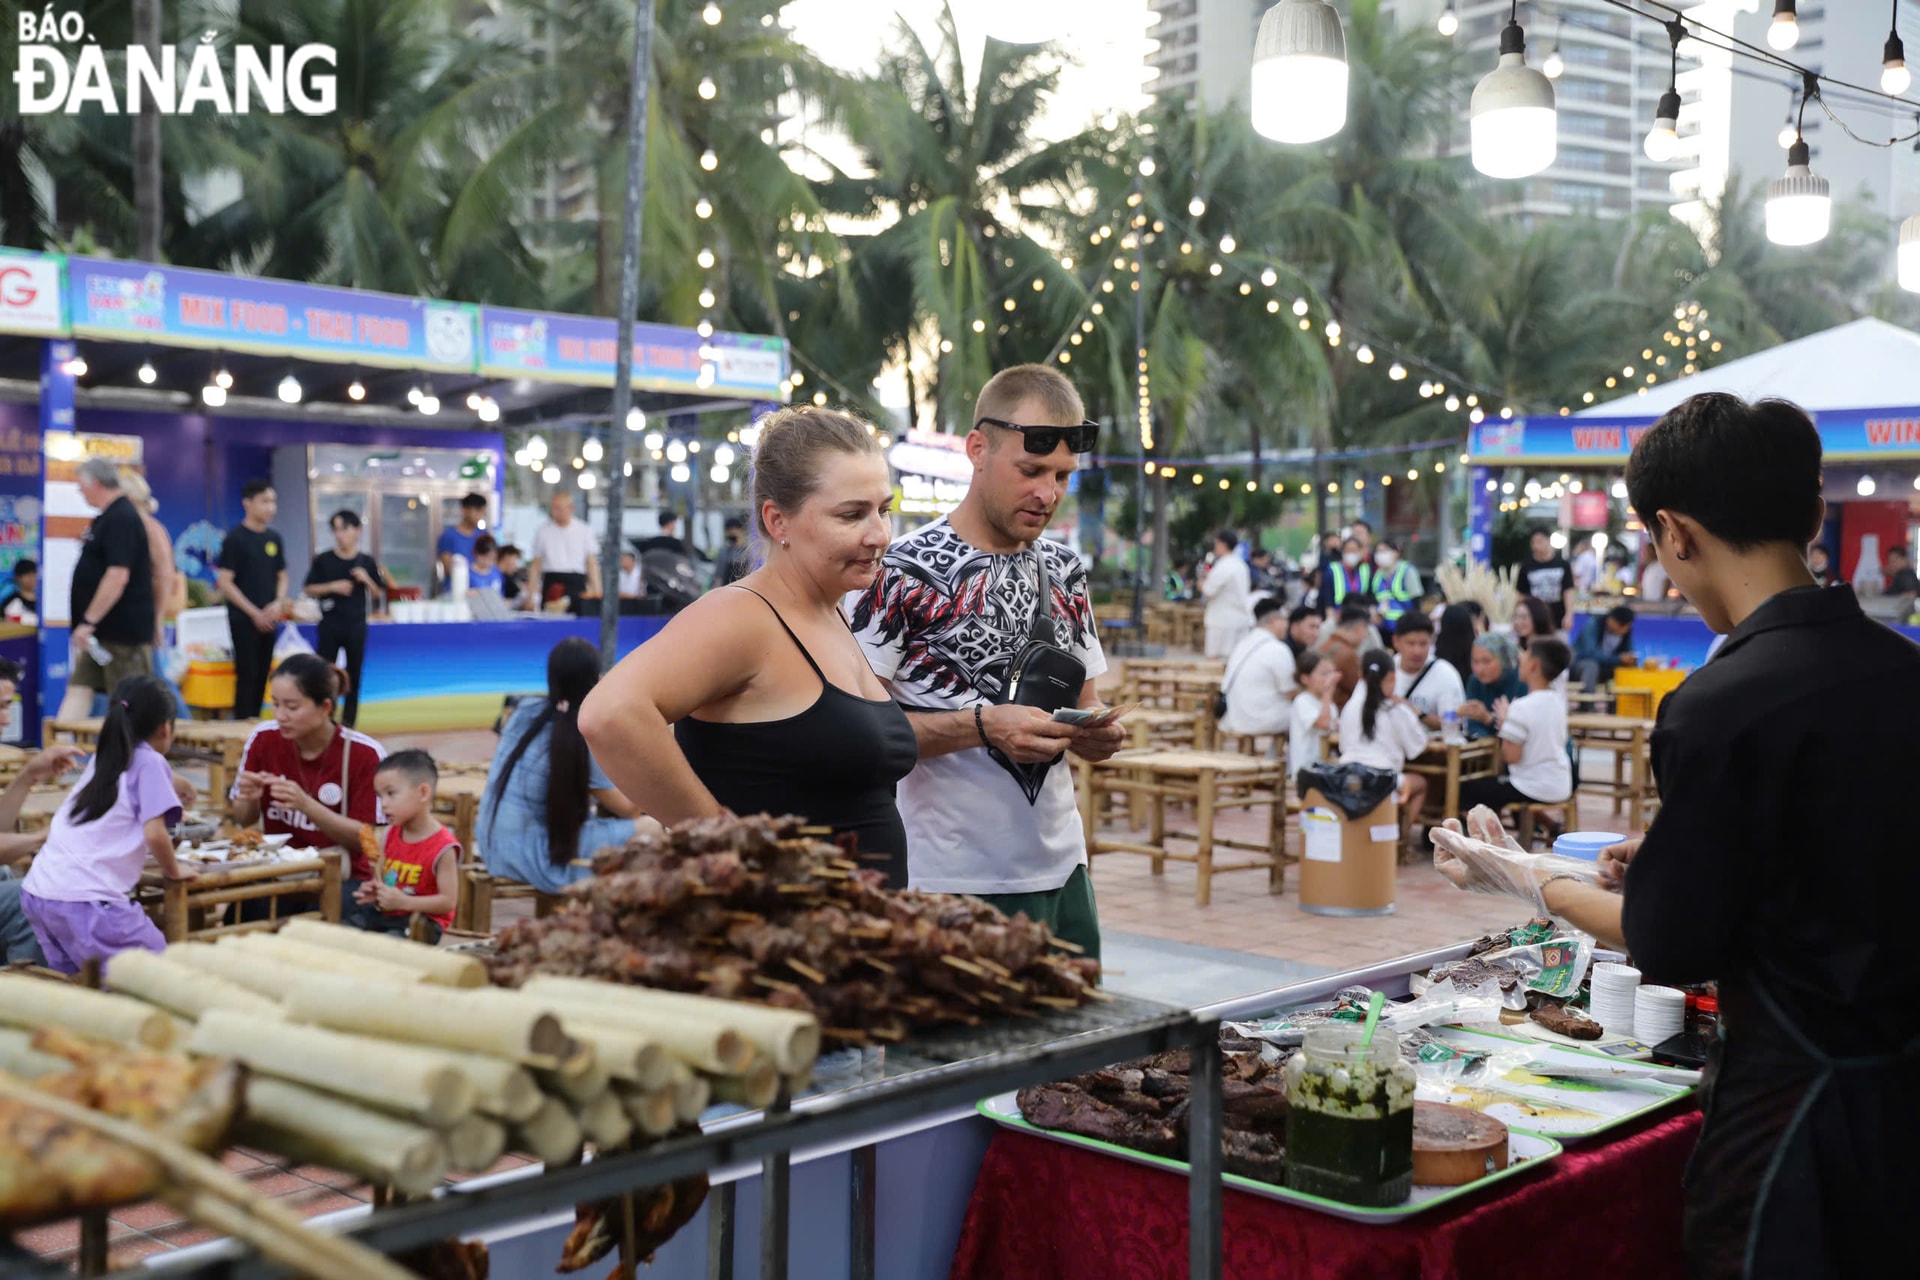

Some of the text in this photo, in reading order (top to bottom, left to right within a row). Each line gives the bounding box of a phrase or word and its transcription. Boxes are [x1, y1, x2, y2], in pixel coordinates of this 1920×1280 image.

[180, 293, 226, 328] MIX
[231, 300, 288, 335] FOOD
[306, 308, 354, 343] THAI
[357, 315, 410, 349] FOOD
[1572, 425, 1622, 450] WIN
